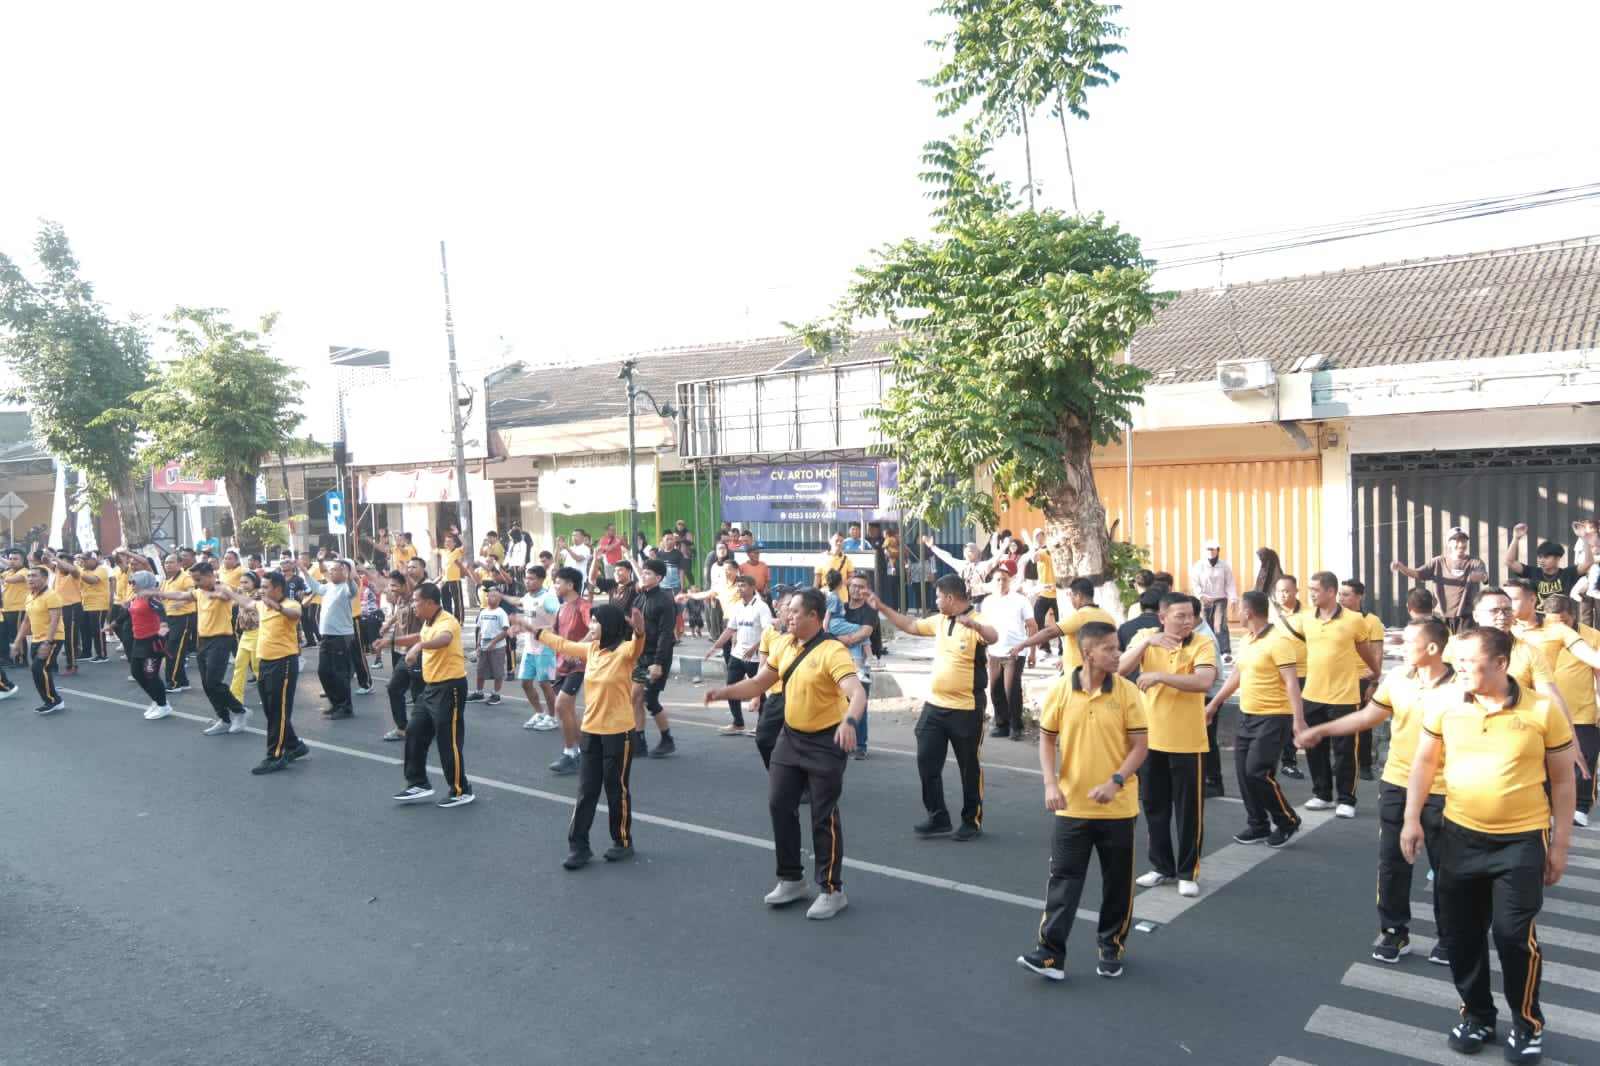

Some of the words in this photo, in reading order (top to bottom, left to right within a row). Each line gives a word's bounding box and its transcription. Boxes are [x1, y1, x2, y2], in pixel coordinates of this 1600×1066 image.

[770, 471, 785, 480] CV.
[787, 470, 813, 480] ARTO
[329, 497, 342, 525] P
